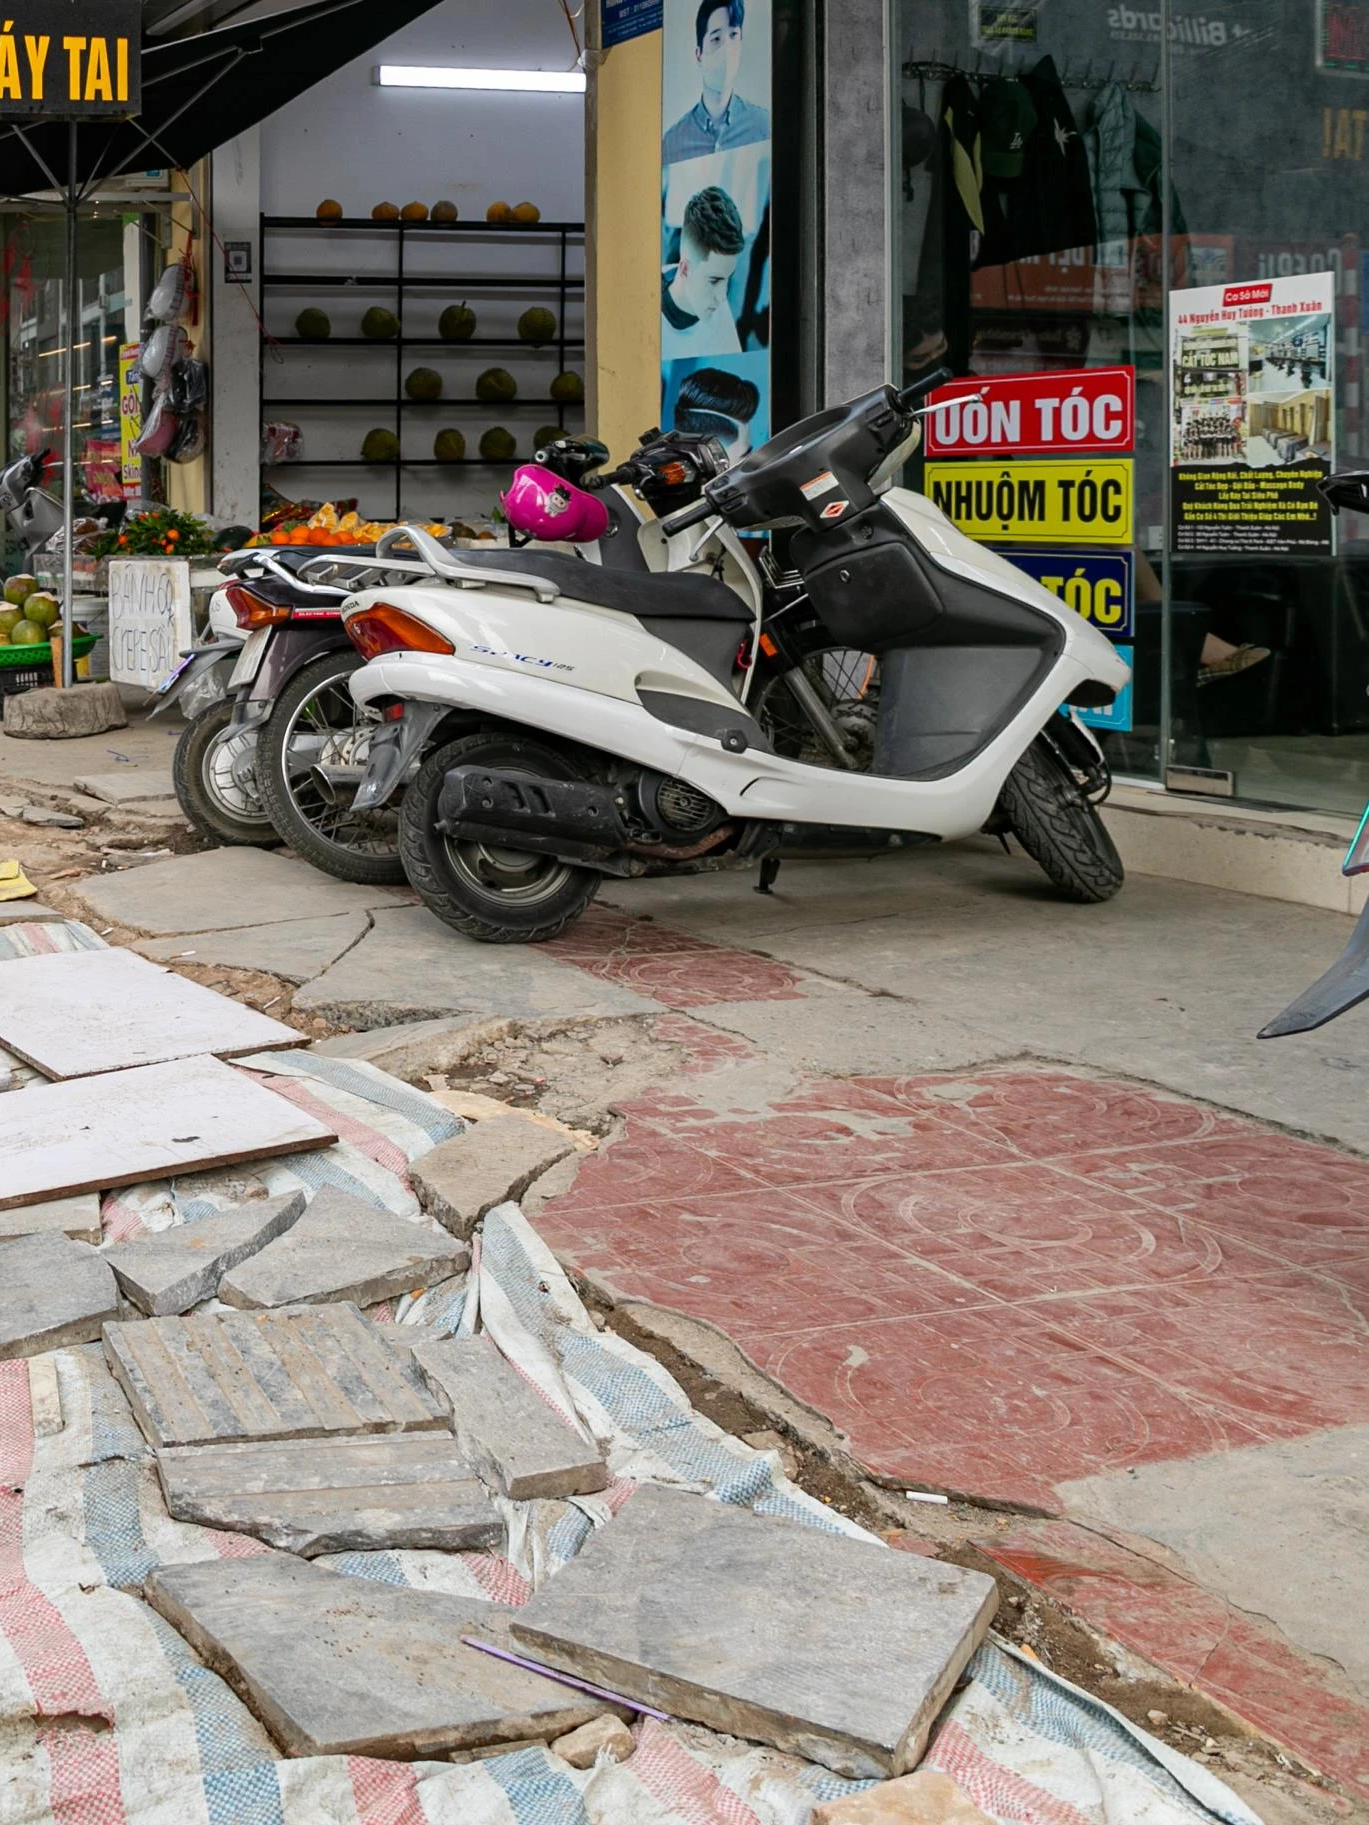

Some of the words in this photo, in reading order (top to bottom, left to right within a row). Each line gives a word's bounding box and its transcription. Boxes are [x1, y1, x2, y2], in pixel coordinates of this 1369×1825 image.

[63, 36, 128, 101] TAI
[1035, 386, 1123, 442] TÓC
[933, 470, 1046, 531] NHUỘM
[1058, 469, 1122, 523] TÓC
